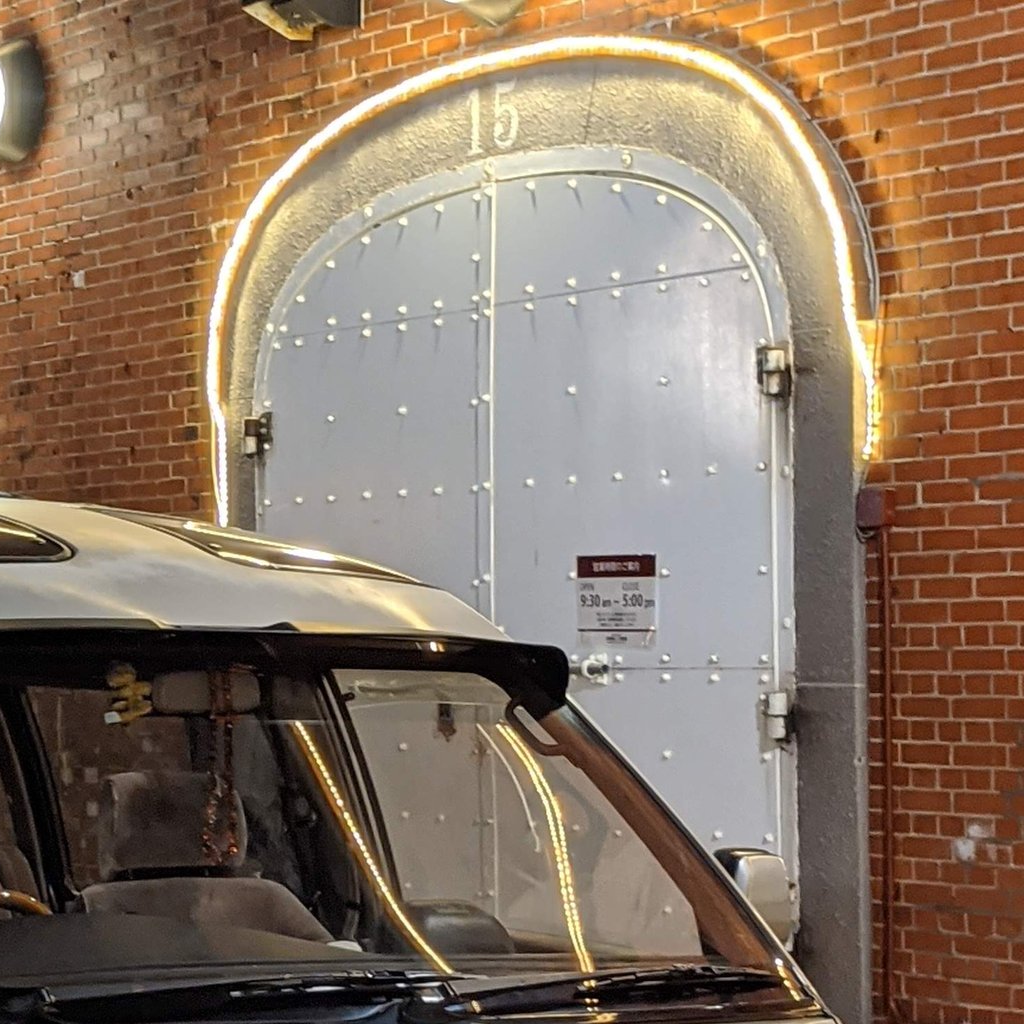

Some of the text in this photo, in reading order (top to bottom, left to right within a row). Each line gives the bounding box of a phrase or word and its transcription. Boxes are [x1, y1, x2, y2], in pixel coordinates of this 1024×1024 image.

[466, 79, 519, 156] 15
[580, 594, 601, 607] 9:30
[622, 593, 643, 607] 5:00
